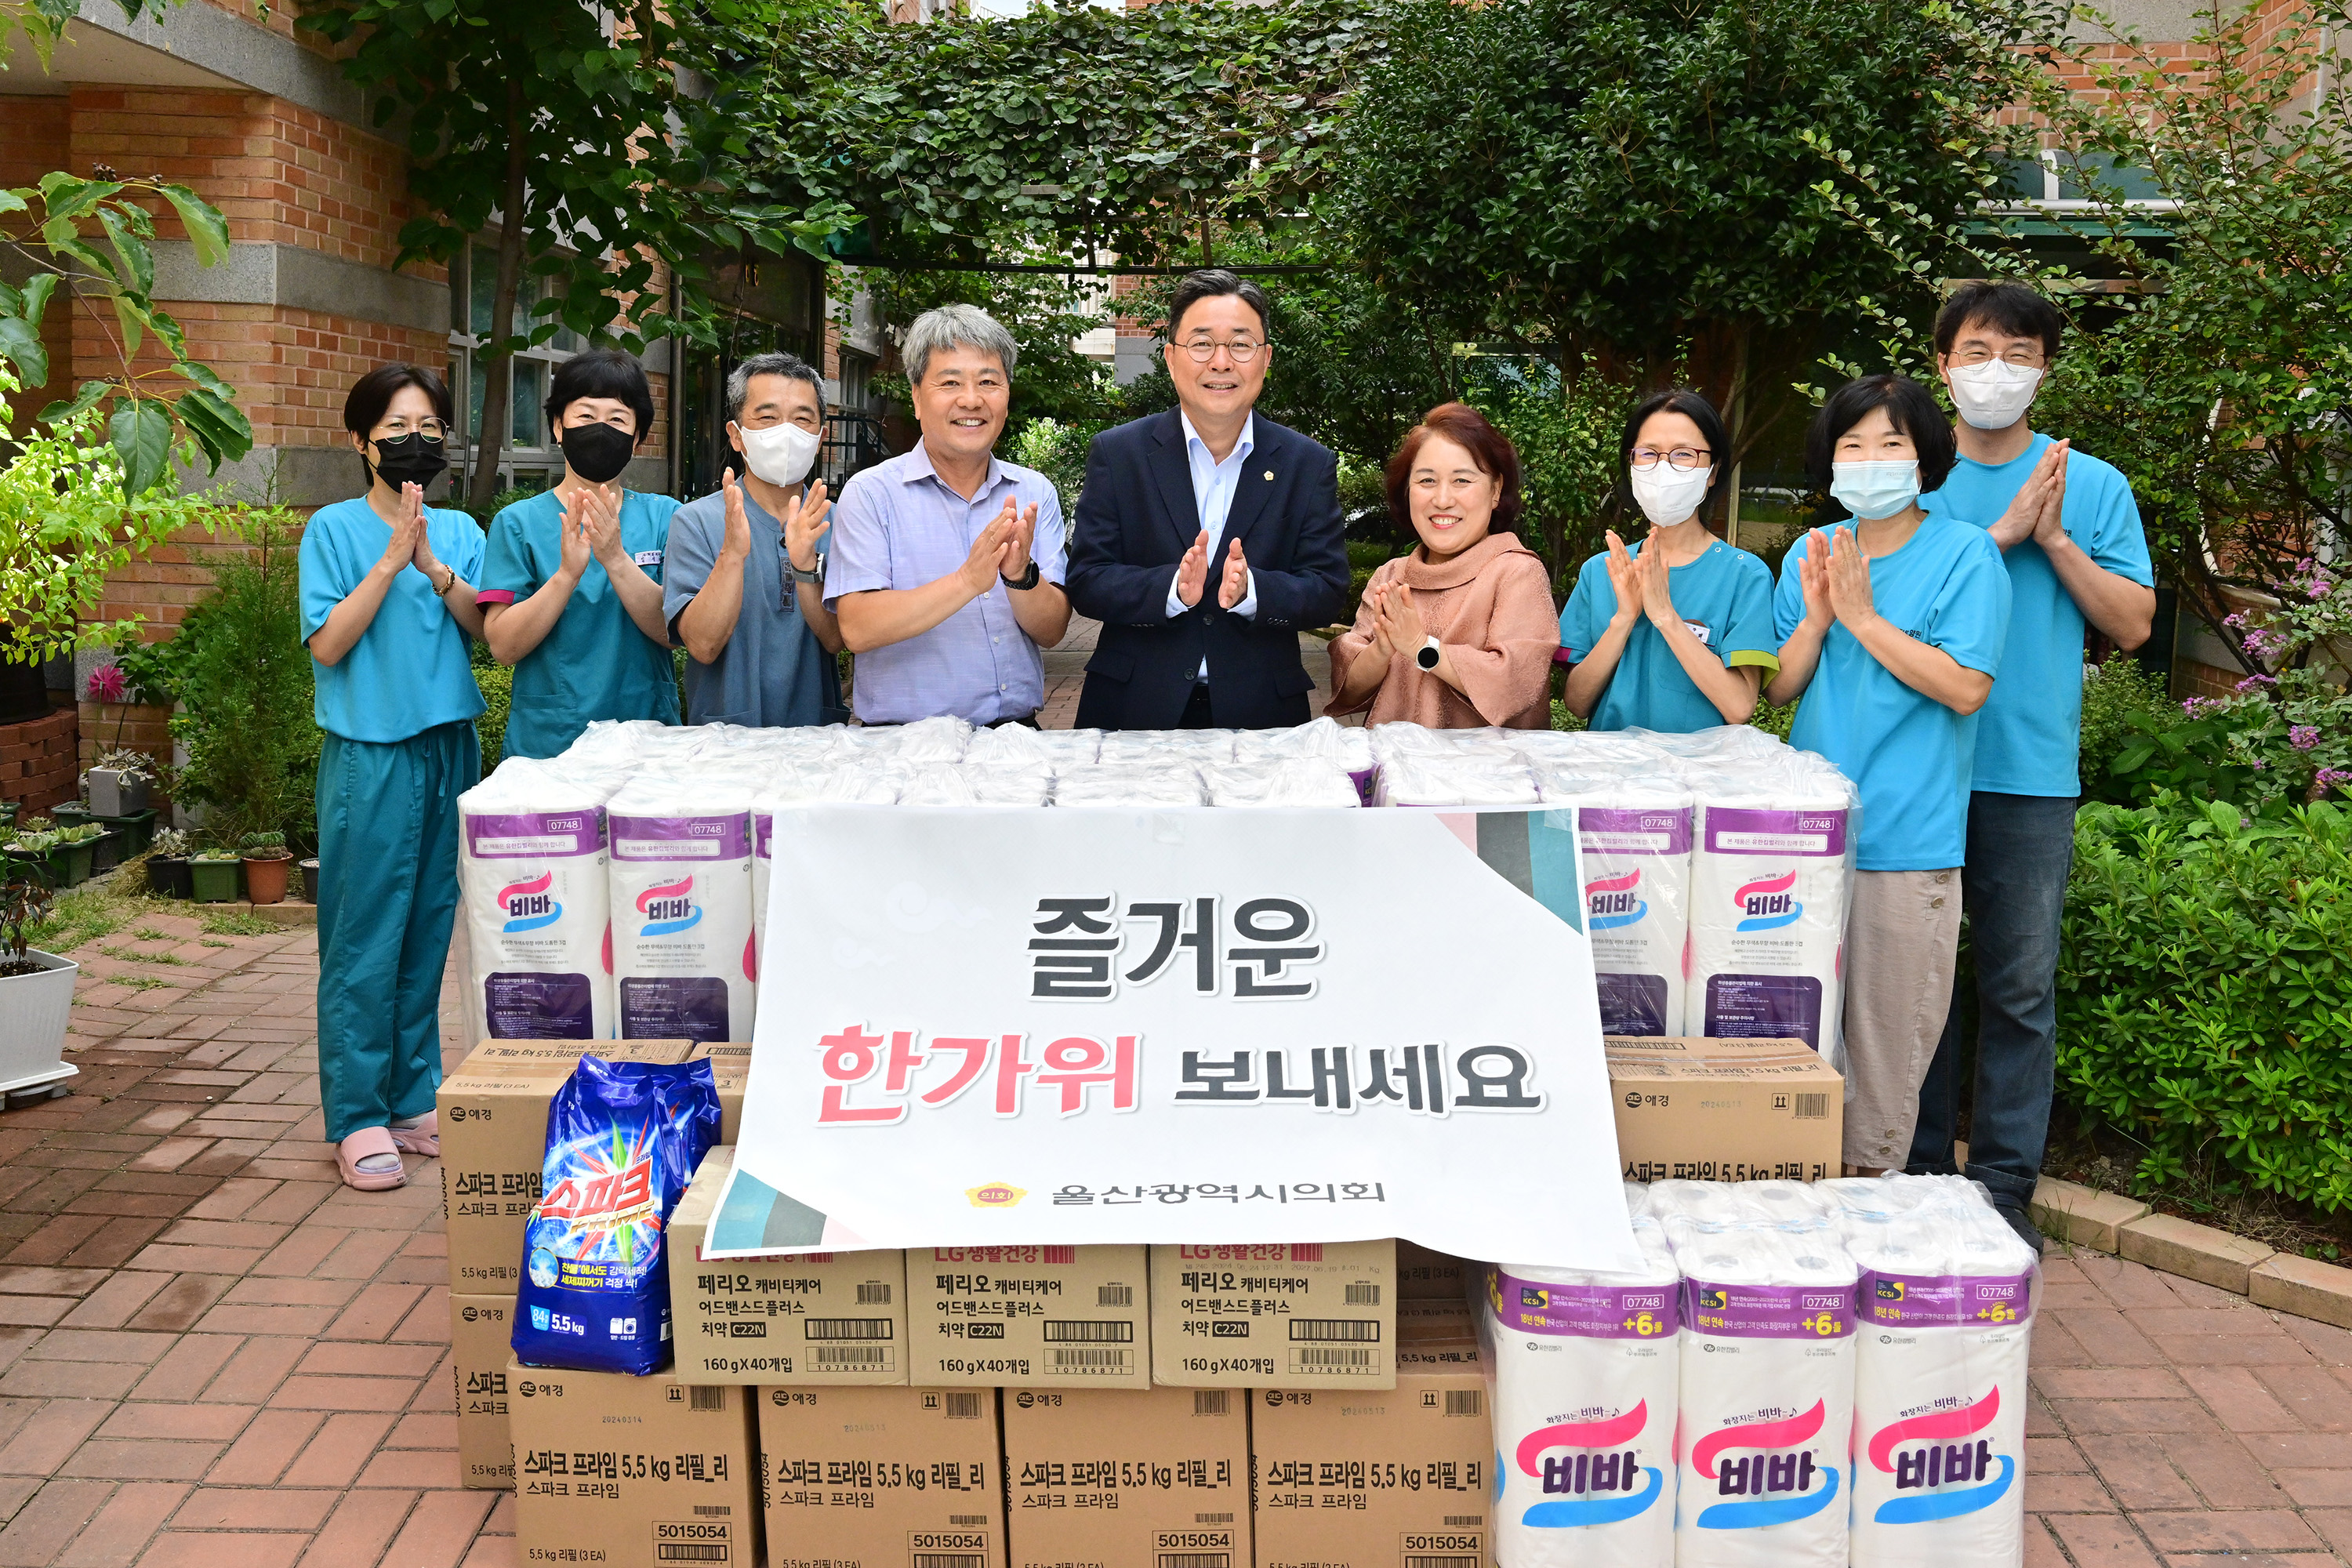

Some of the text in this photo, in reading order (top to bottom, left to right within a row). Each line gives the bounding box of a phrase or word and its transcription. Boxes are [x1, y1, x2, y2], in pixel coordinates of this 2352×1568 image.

[551, 821, 577, 829] 07748
[1645, 818, 1672, 827] 07748
[1803, 820, 1830, 829] 07748
[510, 895, 550, 916] 비바
[649, 898, 691, 919] 비바
[1592, 893, 1635, 913] 비바
[1747, 894, 1791, 914] 비바
[1029, 896, 1319, 996] 즐거운
[818, 1025, 1541, 1120] 한가위 보내세요
[1645, 1095, 1668, 1105] 애경
[468, 1109, 491, 1120] 애경
[636, 1151, 649, 1163] 프라임
[456, 1172, 497, 1197] 스파크
[542, 1163, 651, 1219] 스파크
[978, 1191, 1011, 1200] 의회
[1052, 1182, 1385, 1203] 울산광역시의회
[458, 1202, 498, 1216] 스파크
[570, 1200, 654, 1233] PRIME
[462, 1267, 474, 1279] 5.5
[477, 1267, 486, 1279] kg
[489, 1267, 506, 1277] 리필
[610, 1266, 646, 1276] 강력세척!
[561, 1275, 602, 1287] 세제찌꺼기
[605, 1279, 622, 1287] 걱정
[698, 1275, 821, 1294] 페리오 캐비티케어
[936, 1275, 1061, 1294] 페리오 캐비티케어
[1181, 1272, 1308, 1293] 페리오 캐비티케어
[1877, 1290, 1893, 1298] KCSI
[1981, 1287, 2013, 1297] 07748
[699, 1301, 804, 1316] 어드밴스드플러스
[937, 1301, 1044, 1316] 어드밴스드플러스
[1181, 1299, 1289, 1314] 어드밴스드플러스
[1627, 1298, 1659, 1307] 07748
[1807, 1298, 1838, 1307] 07748
[481, 1308, 503, 1319] 애경
[1520, 1313, 1545, 1327] 18년 연속
[1875, 1306, 1900, 1319] 18년 연속
[551, 1314, 570, 1330] 5.5
[572, 1322, 583, 1334] kg
[1182, 1321, 1246, 1336] 치약 C22N
[1698, 1316, 1709, 1326] 18년
[1711, 1317, 1723, 1327] 연속
[702, 1322, 764, 1337] 치약 C22N
[938, 1323, 1002, 1338] 치약 C22N
[467, 1372, 506, 1396] 스파크
[539, 1384, 562, 1396] 애경
[792, 1392, 816, 1404] 애경
[1037, 1394, 1062, 1406] 애경
[1287, 1392, 1311, 1404] 애경
[469, 1400, 508, 1415] 스파크
[1900, 1404, 1930, 1417] 화장지는
[602, 1415, 641, 1424] 20240314
[1546, 1413, 1577, 1423] 화장지는
[1723, 1414, 1754, 1425] 화장지는
[524, 1450, 727, 1482] 스파크 프라임 5.5 kg 리필_리
[1896, 1439, 1991, 1489] 비바
[778, 1459, 984, 1490] 스파크 프라임 5.5 kg 리필_리
[1020, 1459, 1230, 1488] 스파크 프라임 5.5 kg 리필_리
[1267, 1461, 1480, 1490] 스파크 프라임 5.5 kg 리필_리
[1542, 1451, 1639, 1493] 비바
[1719, 1450, 1816, 1495] 비바
[526, 1482, 619, 1498] 스파크 프라임
[780, 1491, 873, 1507] 스파크 프라임
[1022, 1493, 1118, 1508] 스파크 프라임
[1268, 1494, 1366, 1509] 스파크 프라임
[658, 1525, 726, 1537] 5015054
[913, 1534, 983, 1548] 5015054
[1158, 1534, 1229, 1546] 5015054
[1405, 1536, 1477, 1548] 5015054
[529, 1548, 605, 1561] 5.5 kg 리필 (3 EA)
